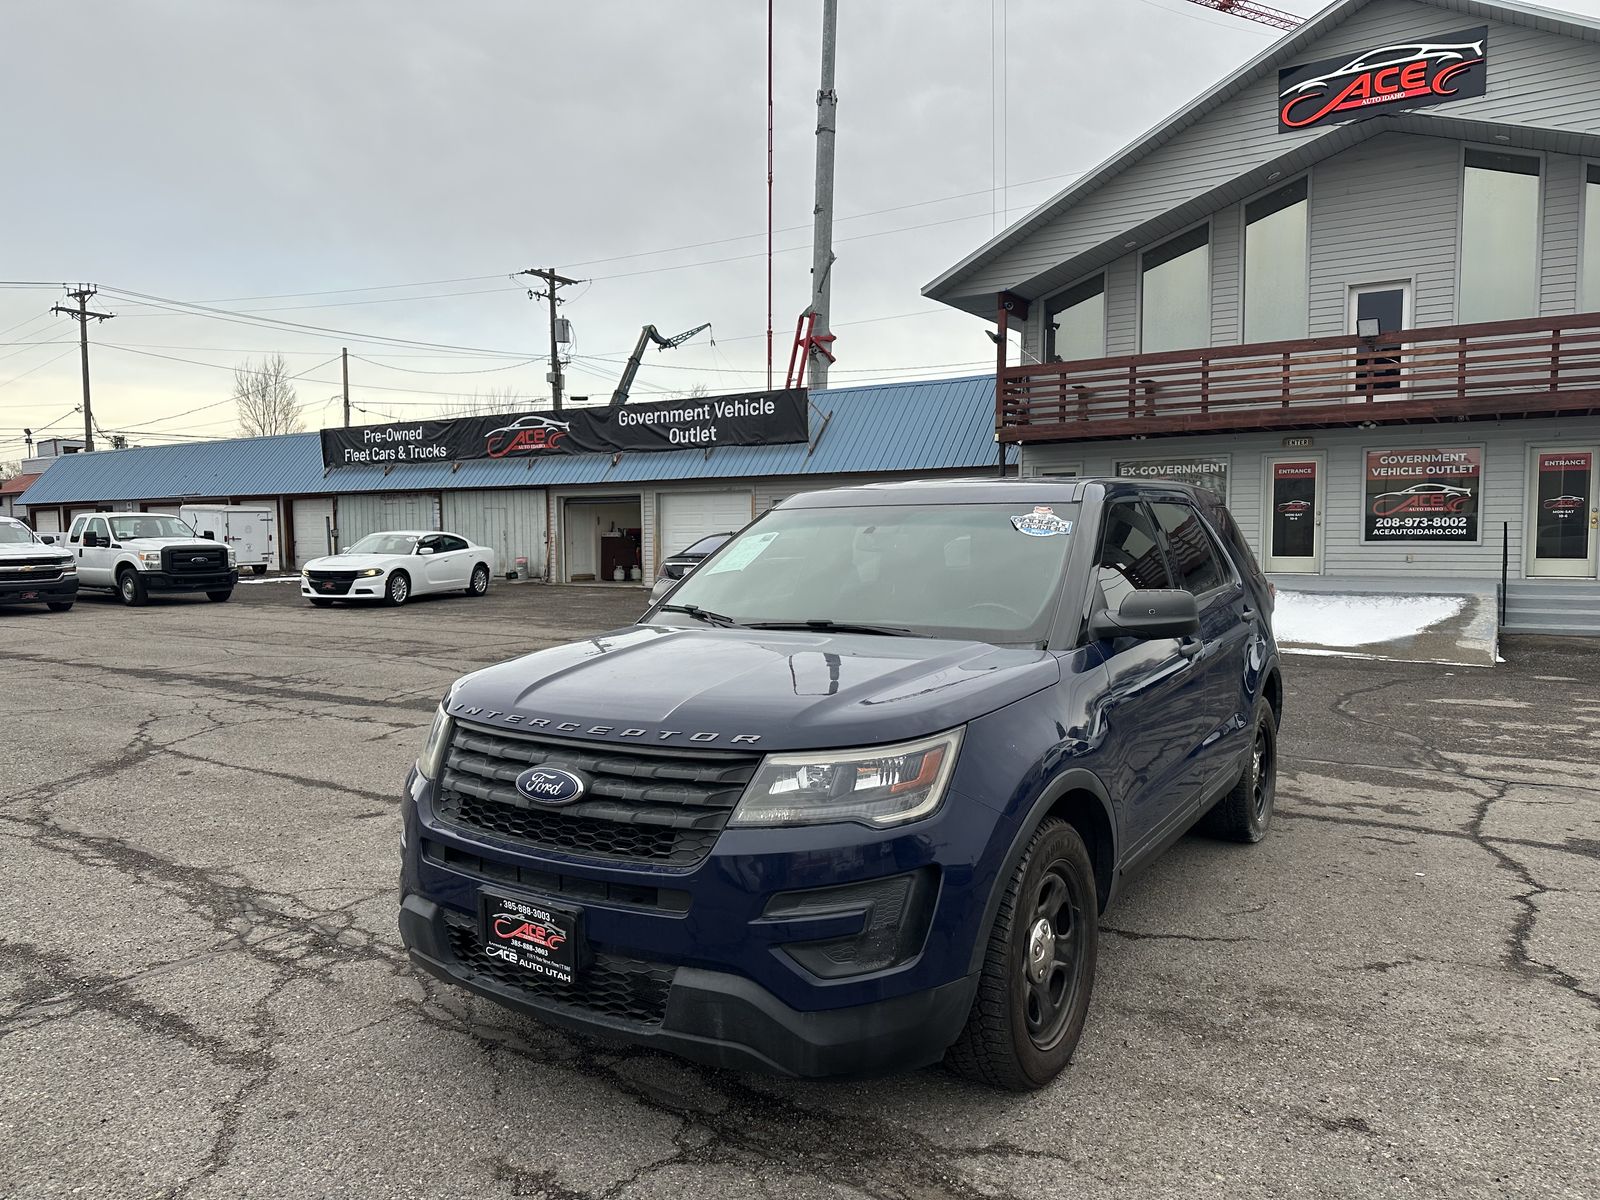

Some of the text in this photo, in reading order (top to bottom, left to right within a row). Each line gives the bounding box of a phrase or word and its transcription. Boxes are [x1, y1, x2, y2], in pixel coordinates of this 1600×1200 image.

[1361, 92, 1406, 106] AUTO IDAHO
[618, 398, 775, 426] Government Vehicle
[364, 426, 423, 443] Pre-Owned
[669, 426, 717, 444] Outlet
[344, 444, 447, 462] Fleet Cars & Trucks
[1380, 453, 1467, 464] GOVERNMENT
[1121, 463, 1228, 476] EX-GOVERNMENT
[1372, 464, 1475, 476] VEHICLE OUTLET
[1375, 517, 1467, 527] 208-973-8002
[453, 703, 763, 744] INTERCEPTOR
[525, 771, 562, 797] Ford
[503, 900, 551, 922] 385-888-3003
[519, 959, 544, 973] AUTO
[545, 967, 571, 983] UTAH
